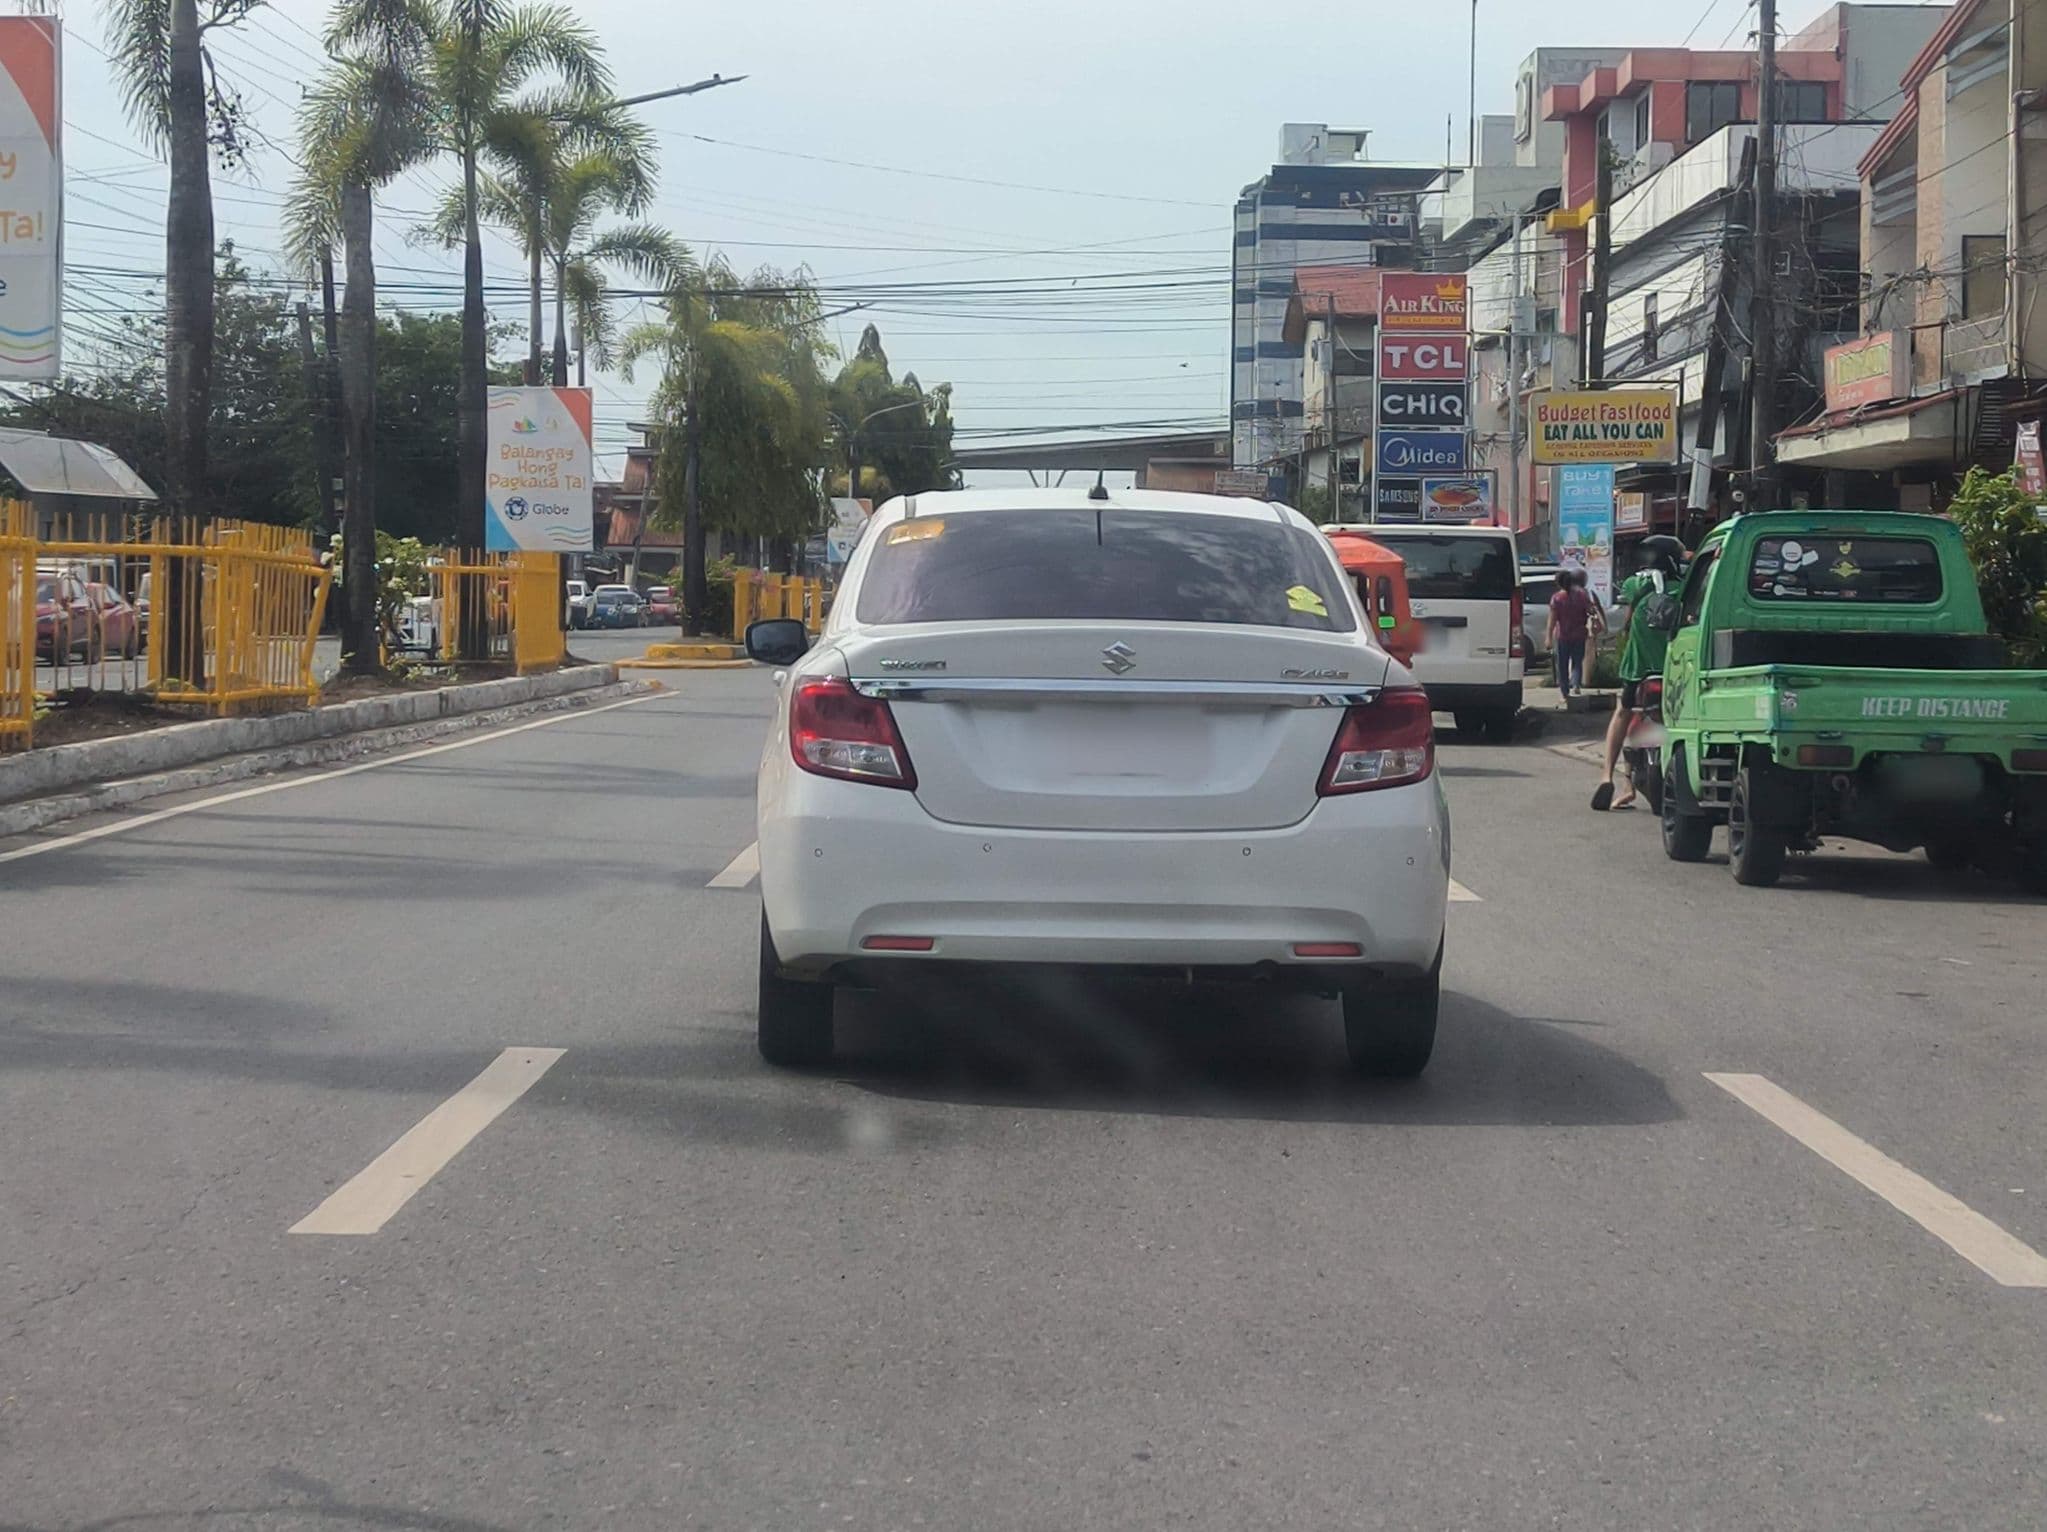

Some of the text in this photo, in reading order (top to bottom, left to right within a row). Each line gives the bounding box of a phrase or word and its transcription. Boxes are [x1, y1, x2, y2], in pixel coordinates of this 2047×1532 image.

[1384, 345, 1464, 369] TCL
[1538, 402, 1671, 422] Budget Fastfood
[1544, 422, 1664, 441] EAT ALL YOU CAN
[501, 443, 574, 461] Balangay
[1397, 446, 1457, 464] Midea
[532, 503, 569, 515] Globe
[1862, 697, 2010, 719] KEEP DISTANCE
